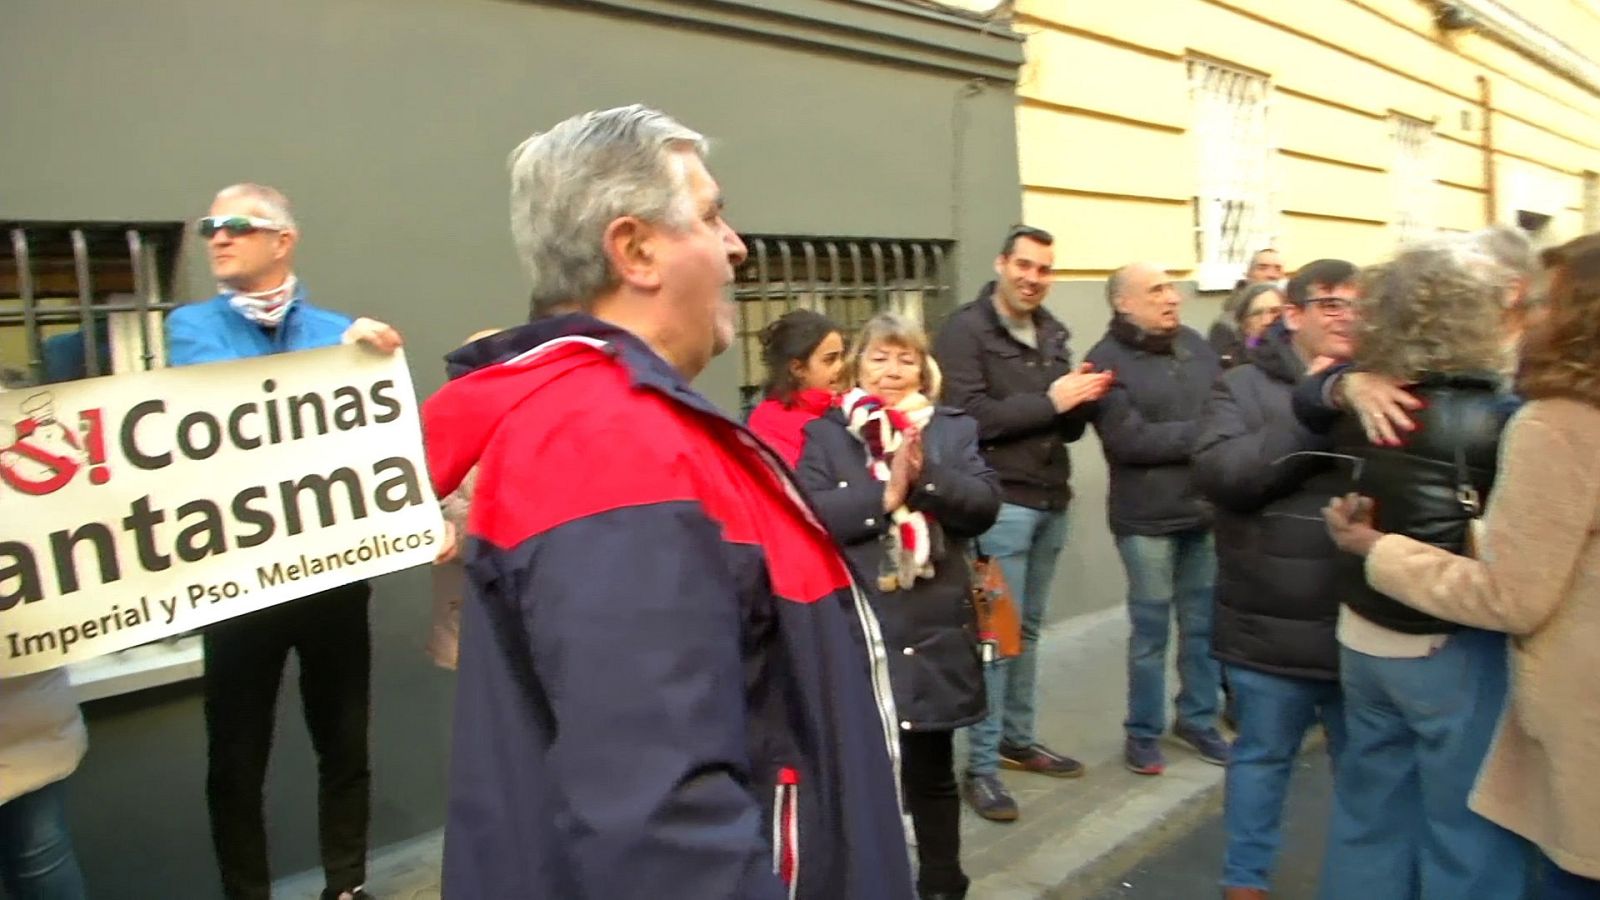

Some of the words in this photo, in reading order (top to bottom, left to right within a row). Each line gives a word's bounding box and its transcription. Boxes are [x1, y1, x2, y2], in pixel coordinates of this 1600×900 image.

[119, 378, 401, 471] Cocinas
[6, 605, 151, 658] Imperial
[160, 596, 177, 624] y
[186, 580, 250, 609] Pso.
[256, 528, 435, 590] Melancólicos
